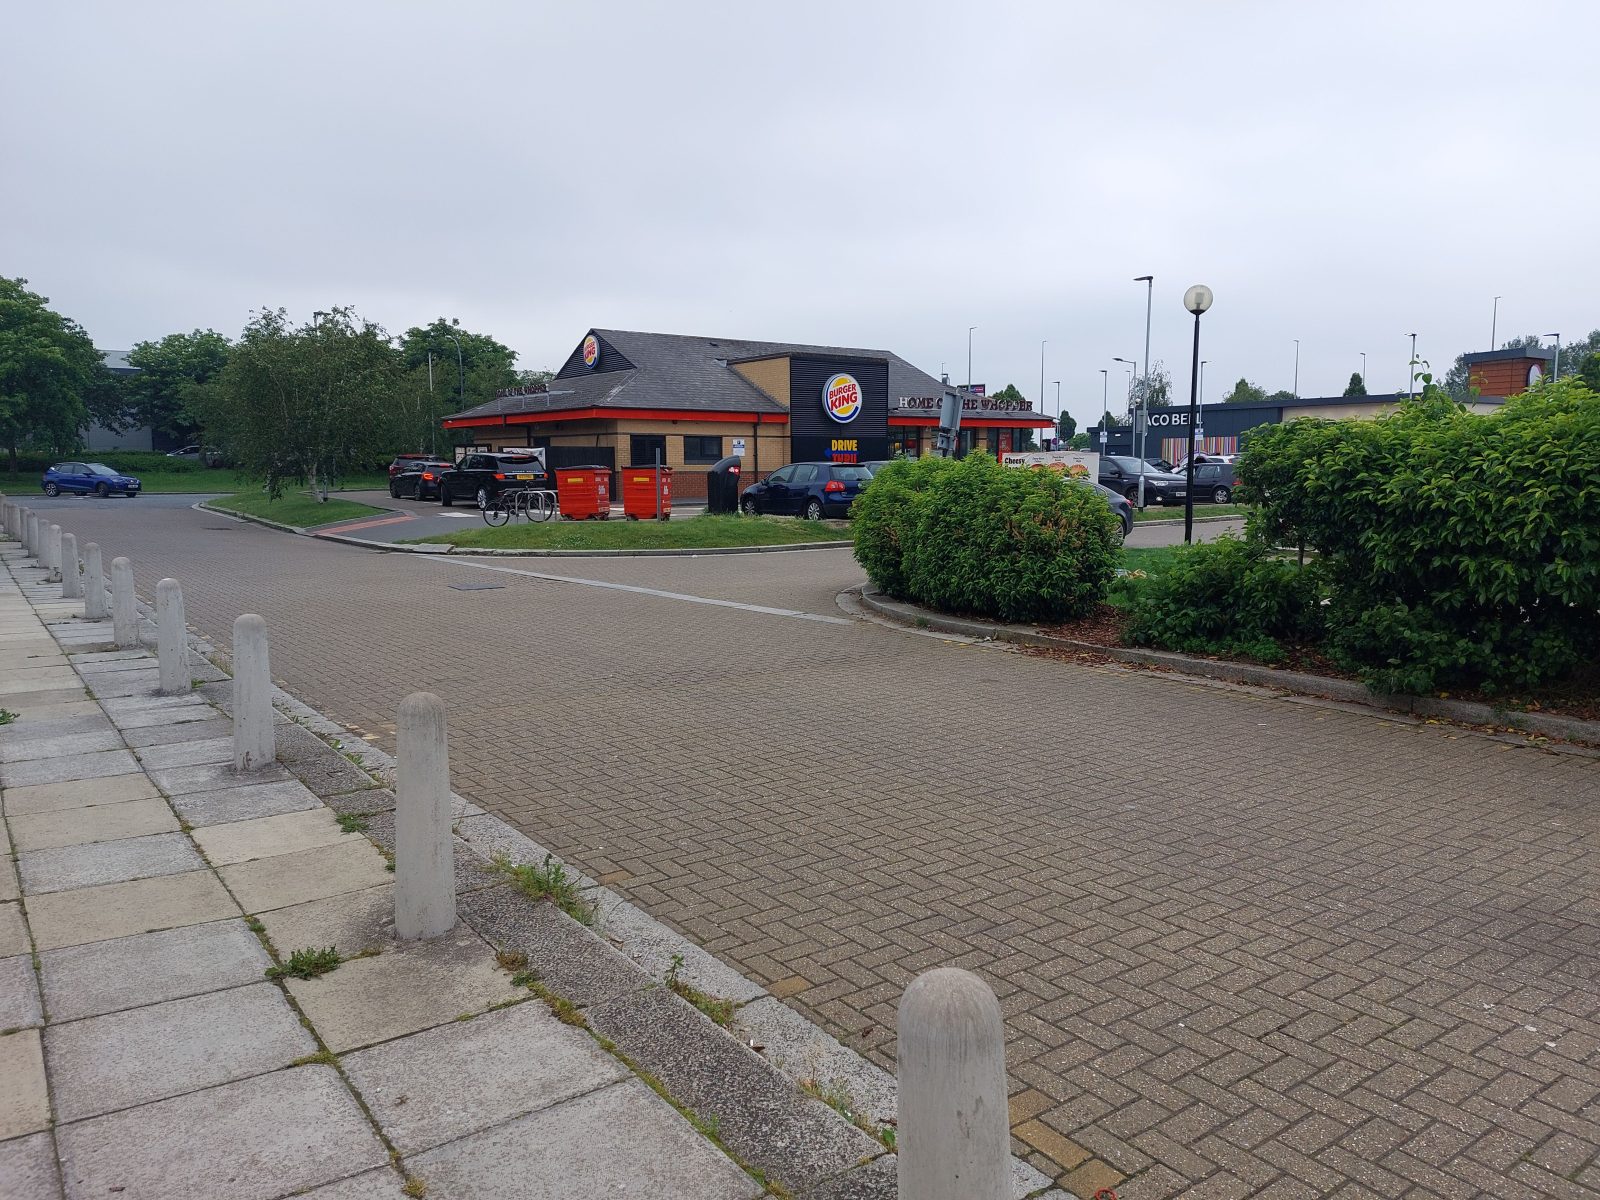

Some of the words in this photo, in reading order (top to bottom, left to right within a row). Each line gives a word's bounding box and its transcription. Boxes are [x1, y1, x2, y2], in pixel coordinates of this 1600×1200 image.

[829, 383, 857, 399] BURGER
[830, 391, 858, 412] KING
[898, 397, 934, 409] HOME
[962, 398, 978, 410] HE
[980, 399, 1033, 411] WHOPPER
[1147, 414, 1170, 426] ACO
[1171, 413, 1203, 425] BEL
[831, 439, 858, 451] DRIVE
[1004, 457, 1026, 465] Cheesy
